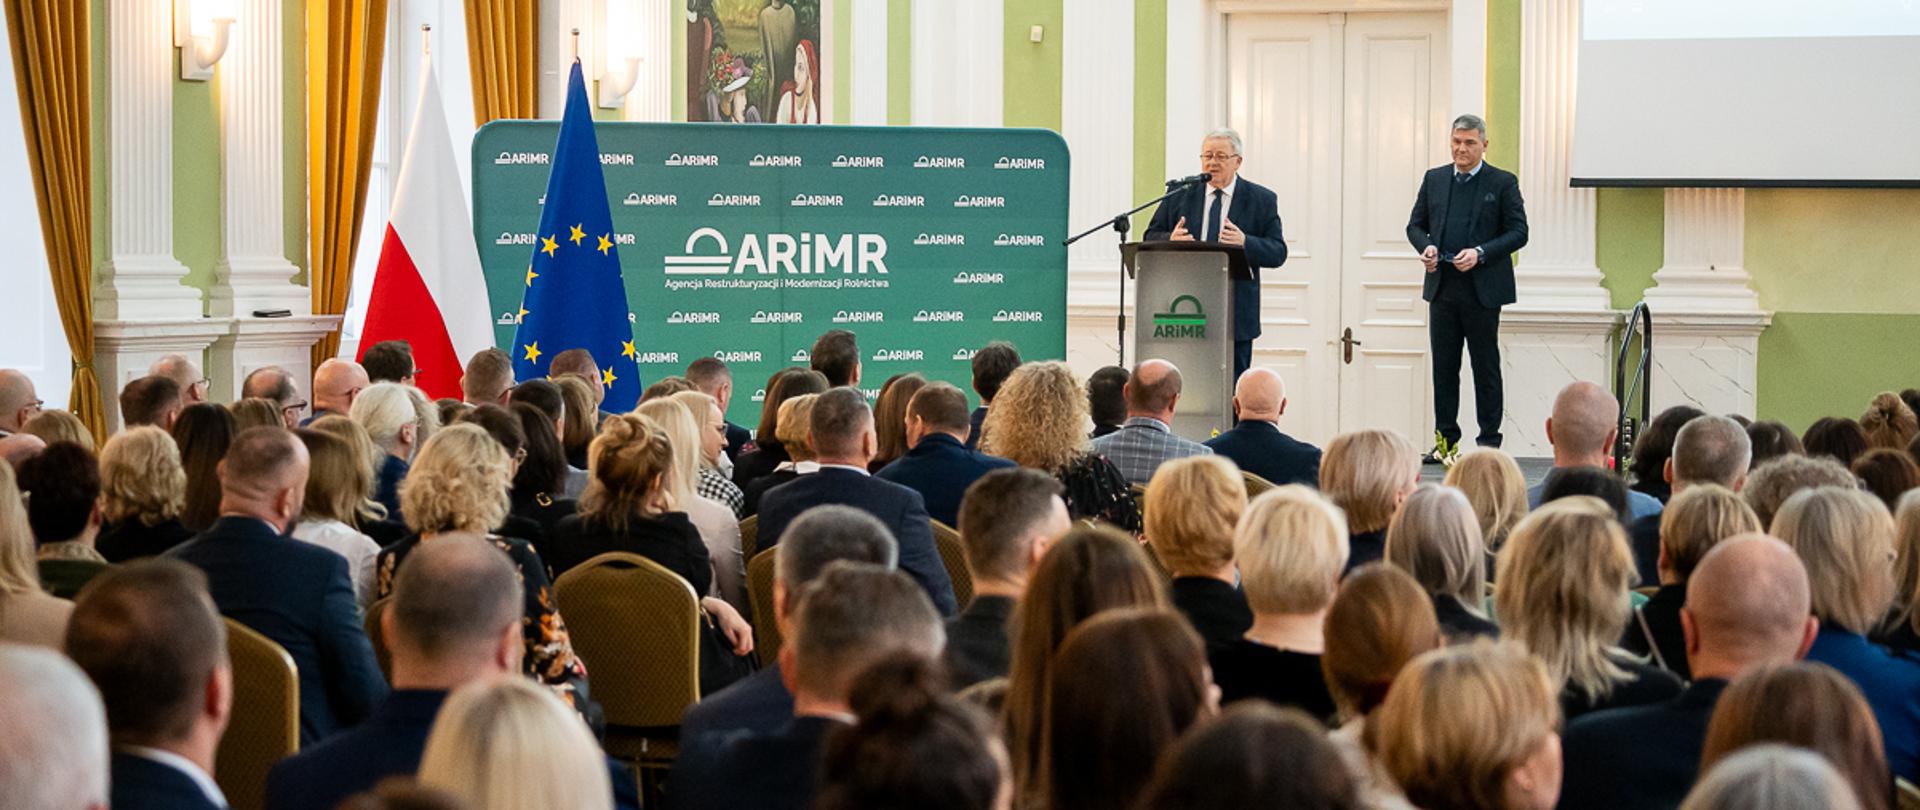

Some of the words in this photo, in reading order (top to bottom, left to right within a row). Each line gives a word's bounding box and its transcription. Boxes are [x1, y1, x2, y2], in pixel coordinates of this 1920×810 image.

[512, 154, 549, 164] ARiMR
[682, 155, 718, 166] ARiMR
[765, 156, 801, 166] ARiMR
[848, 156, 884, 167] ARiMR
[929, 157, 964, 168] ARiMR
[1010, 158, 1044, 169] ARiMR
[640, 195, 676, 205] ARiMR
[724, 195, 760, 205] ARiMR
[807, 196, 843, 206] ARiMR
[888, 196, 924, 206] ARiMR
[970, 196, 1004, 207] ARiMR
[930, 234, 964, 244] ARiMR
[1009, 235, 1044, 246] ARiMR
[734, 232, 888, 274] ARiMR
[969, 273, 1003, 283] ARiMR
[665, 279, 703, 290] Agencja
[705, 278, 779, 290] Restrukturyzacji
[785, 279, 842, 290] Modernizacji
[844, 279, 889, 288] Rolnictwa
[682, 312, 720, 322] ARiMR
[766, 312, 802, 322] ARiMR
[848, 312, 883, 322] ARiMR
[929, 312, 964, 322] ARiMR
[1008, 311, 1042, 321] ARiMR
[1154, 325, 1205, 338] ARiMR
[642, 352, 678, 362] ARiMR
[724, 352, 761, 362] ARiMR
[888, 350, 923, 360] ARiMR
